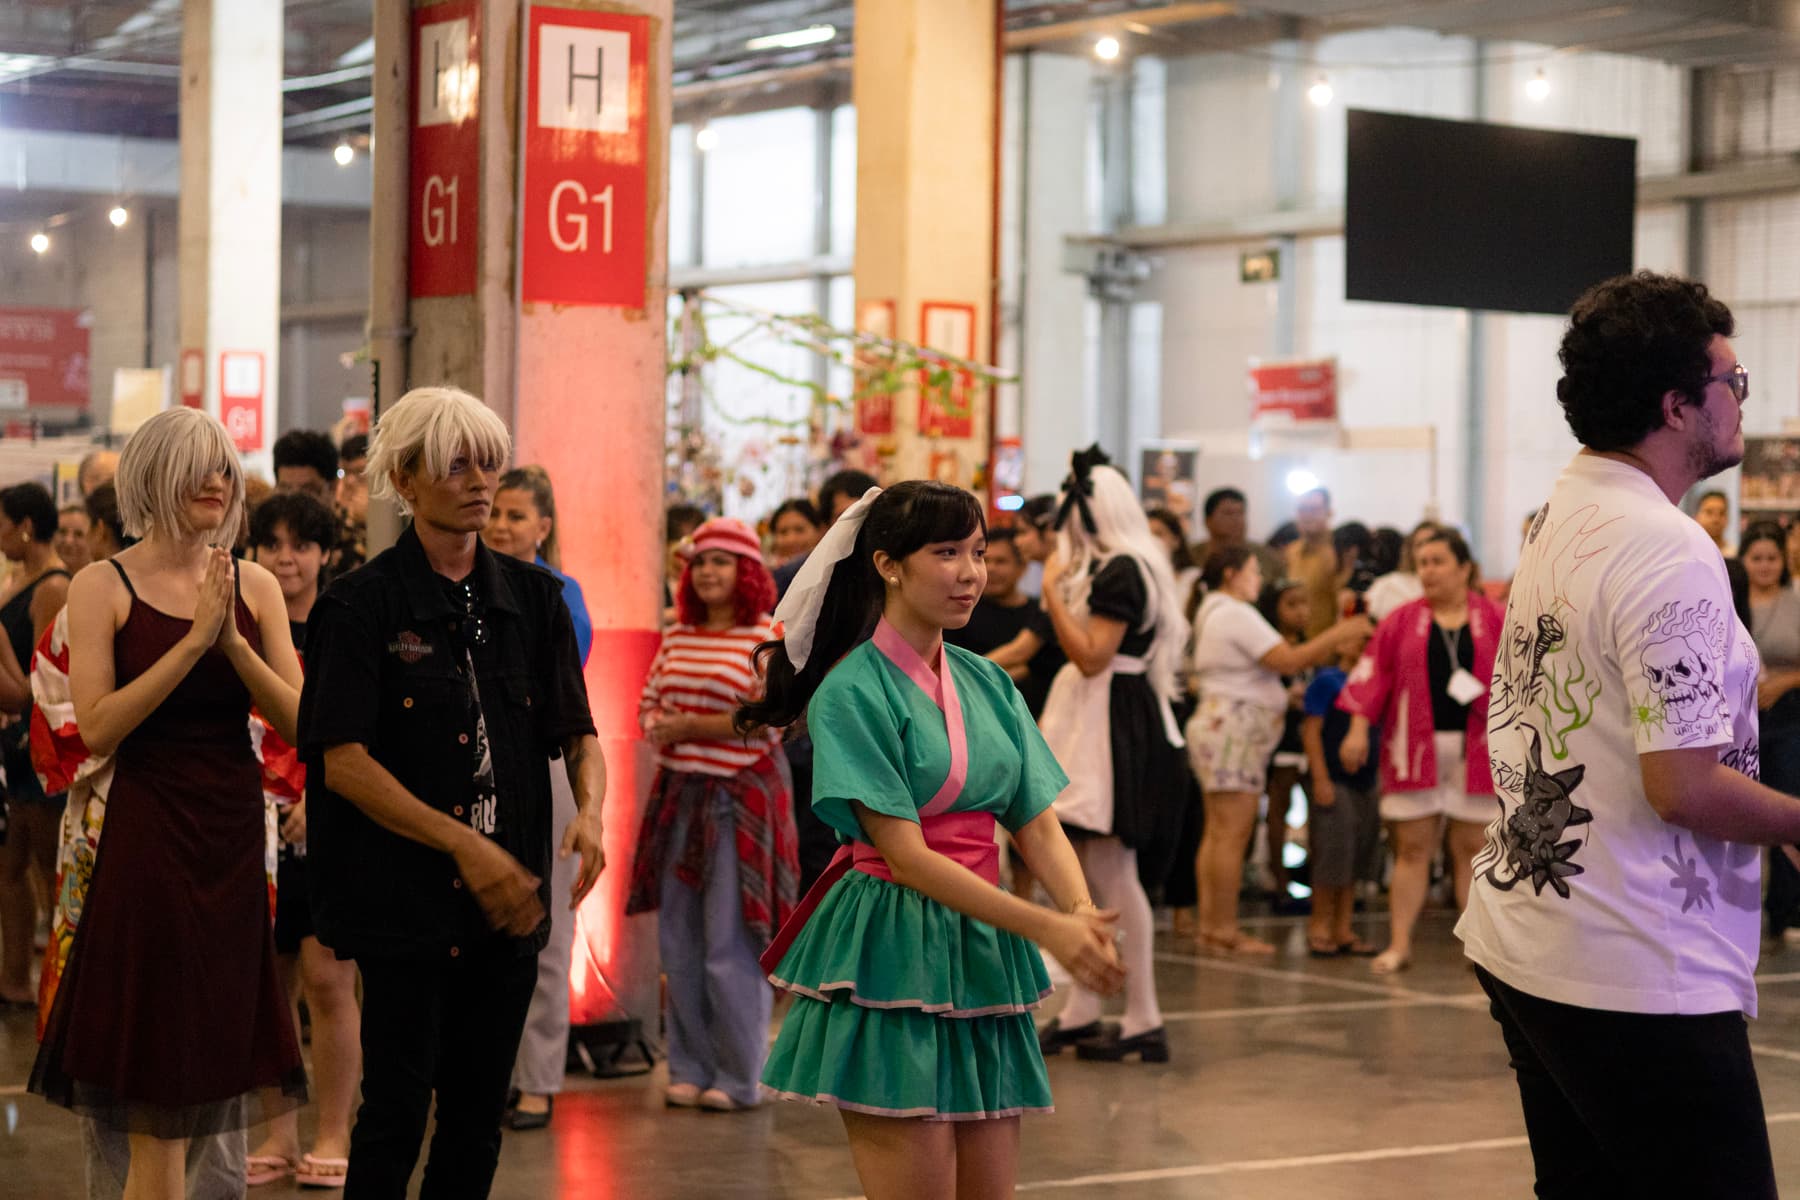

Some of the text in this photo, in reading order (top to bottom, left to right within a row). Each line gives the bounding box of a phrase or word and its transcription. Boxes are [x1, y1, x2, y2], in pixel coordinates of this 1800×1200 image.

[568, 43, 603, 114] H
[421, 174, 459, 248] G1
[548, 179, 614, 254] G1
